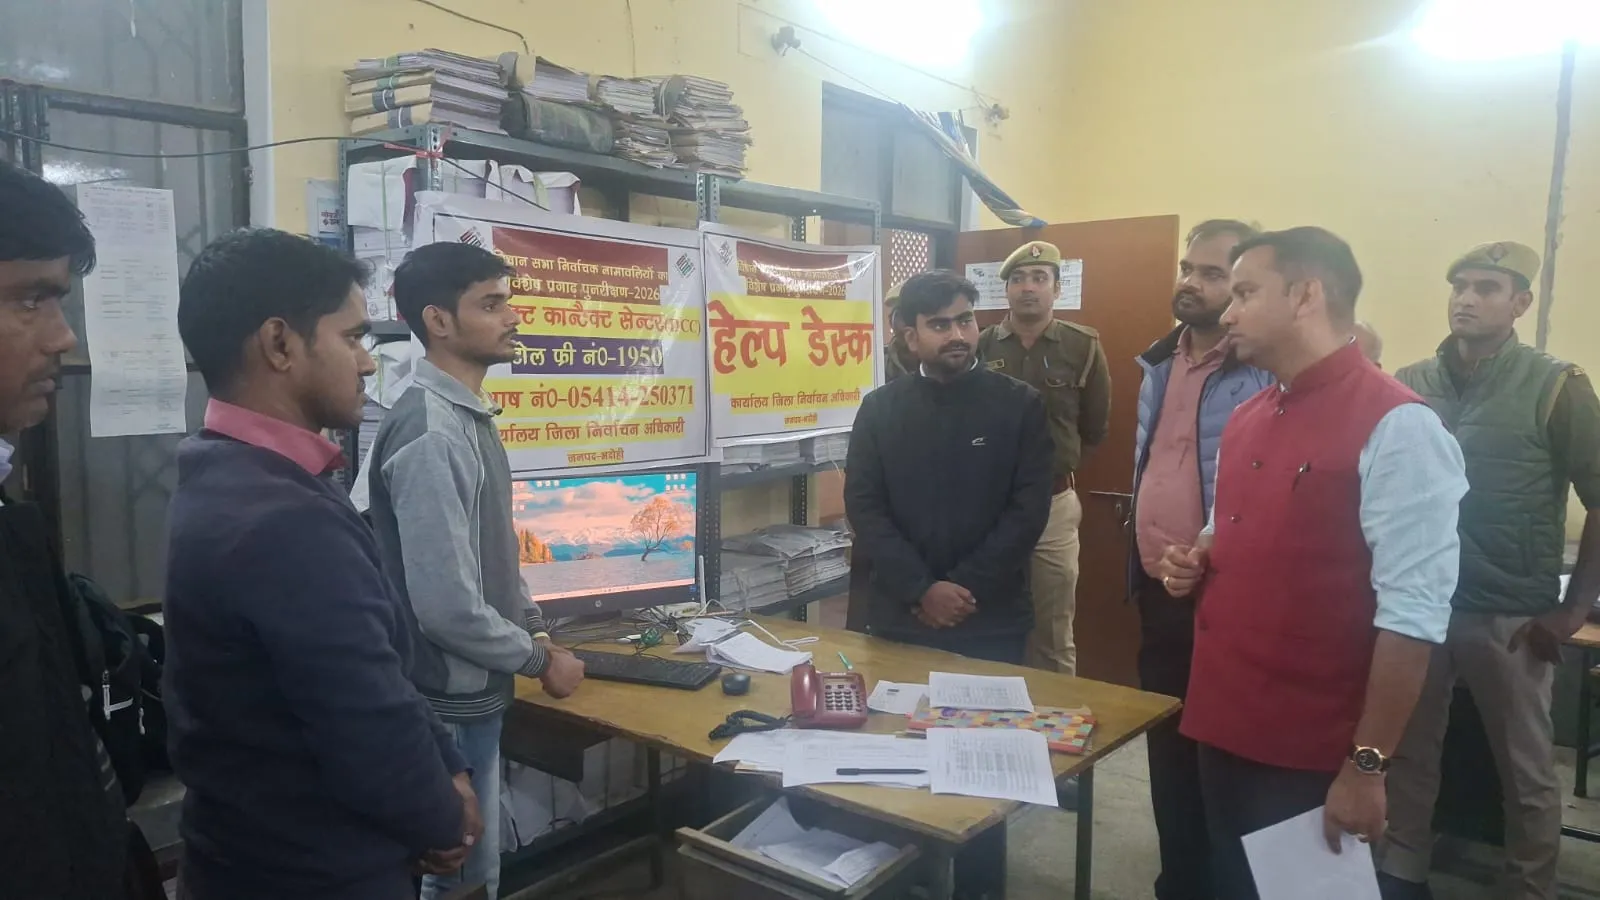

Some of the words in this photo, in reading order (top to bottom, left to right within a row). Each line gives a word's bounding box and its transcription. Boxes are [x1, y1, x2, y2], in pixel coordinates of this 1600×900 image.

[531, 257, 555, 271] सभा
[557, 257, 599, 275] निर्वाचक
[602, 265, 655, 280] नामावलियों
[582, 280, 661, 301] पुनरीक्षण-2026
[707, 300, 791, 375] हेल्प
[801, 305, 875, 367] डेस्क
[552, 341, 577, 367] फ्री
[545, 422, 582, 441] जिला
[587, 419, 640, 438] निर्वाचन
[644, 417, 686, 435] अधिकारी
